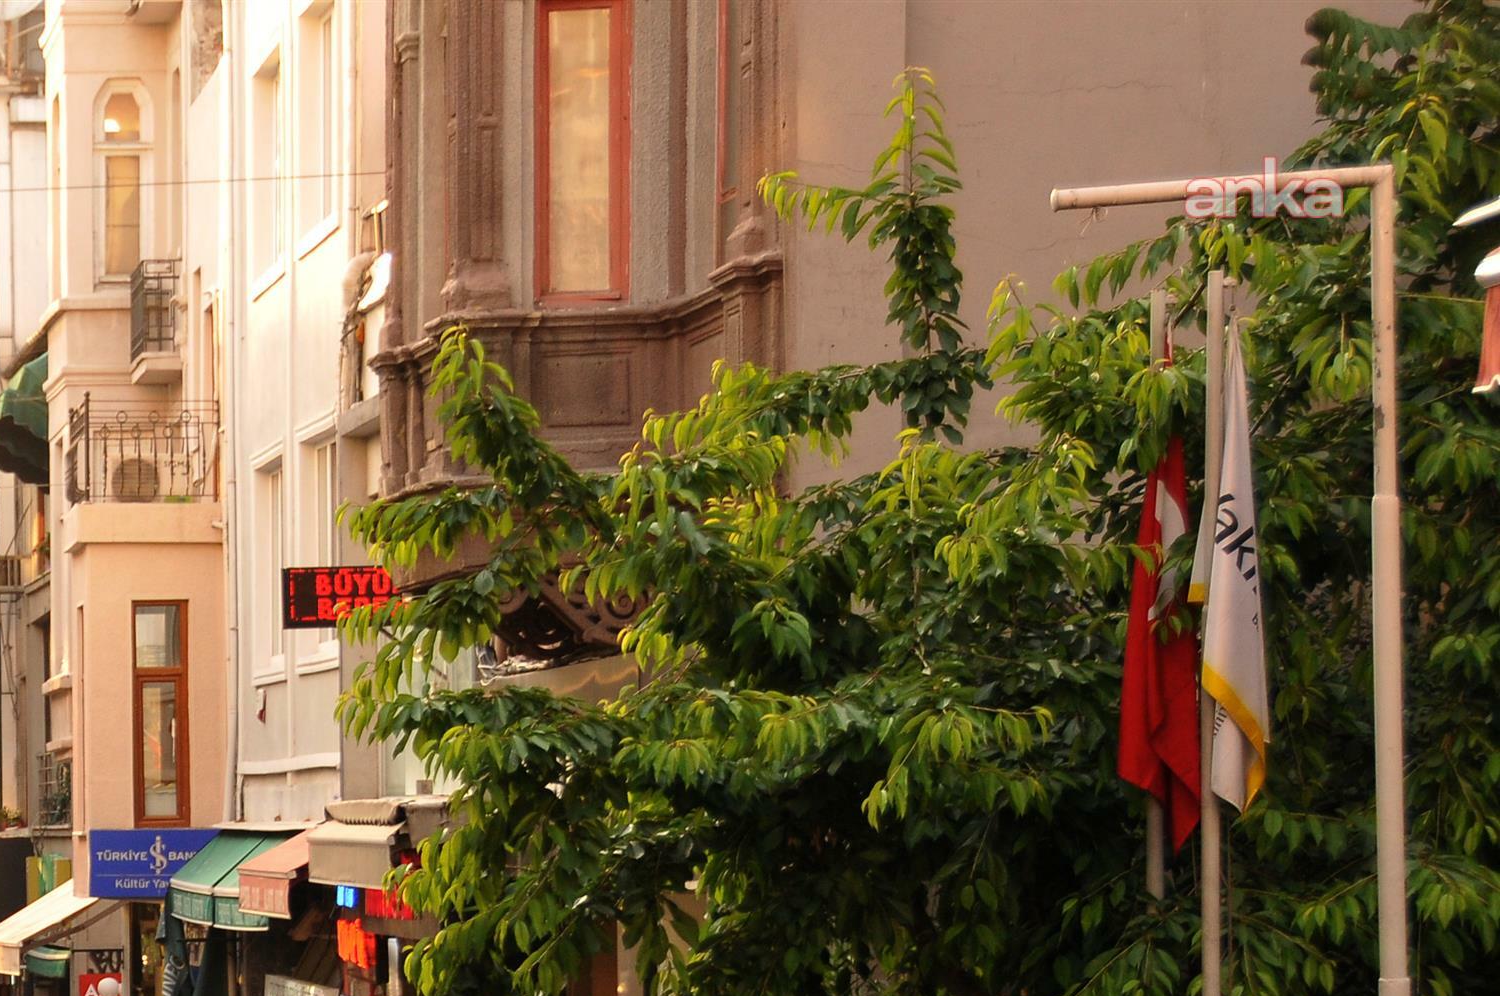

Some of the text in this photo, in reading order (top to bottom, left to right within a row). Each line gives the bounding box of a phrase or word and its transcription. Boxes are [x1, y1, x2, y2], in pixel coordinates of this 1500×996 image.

[96, 849, 148, 862] TÜRKİYE
[168, 850, 198, 861] BAN
[115, 877, 150, 889] Kültür
